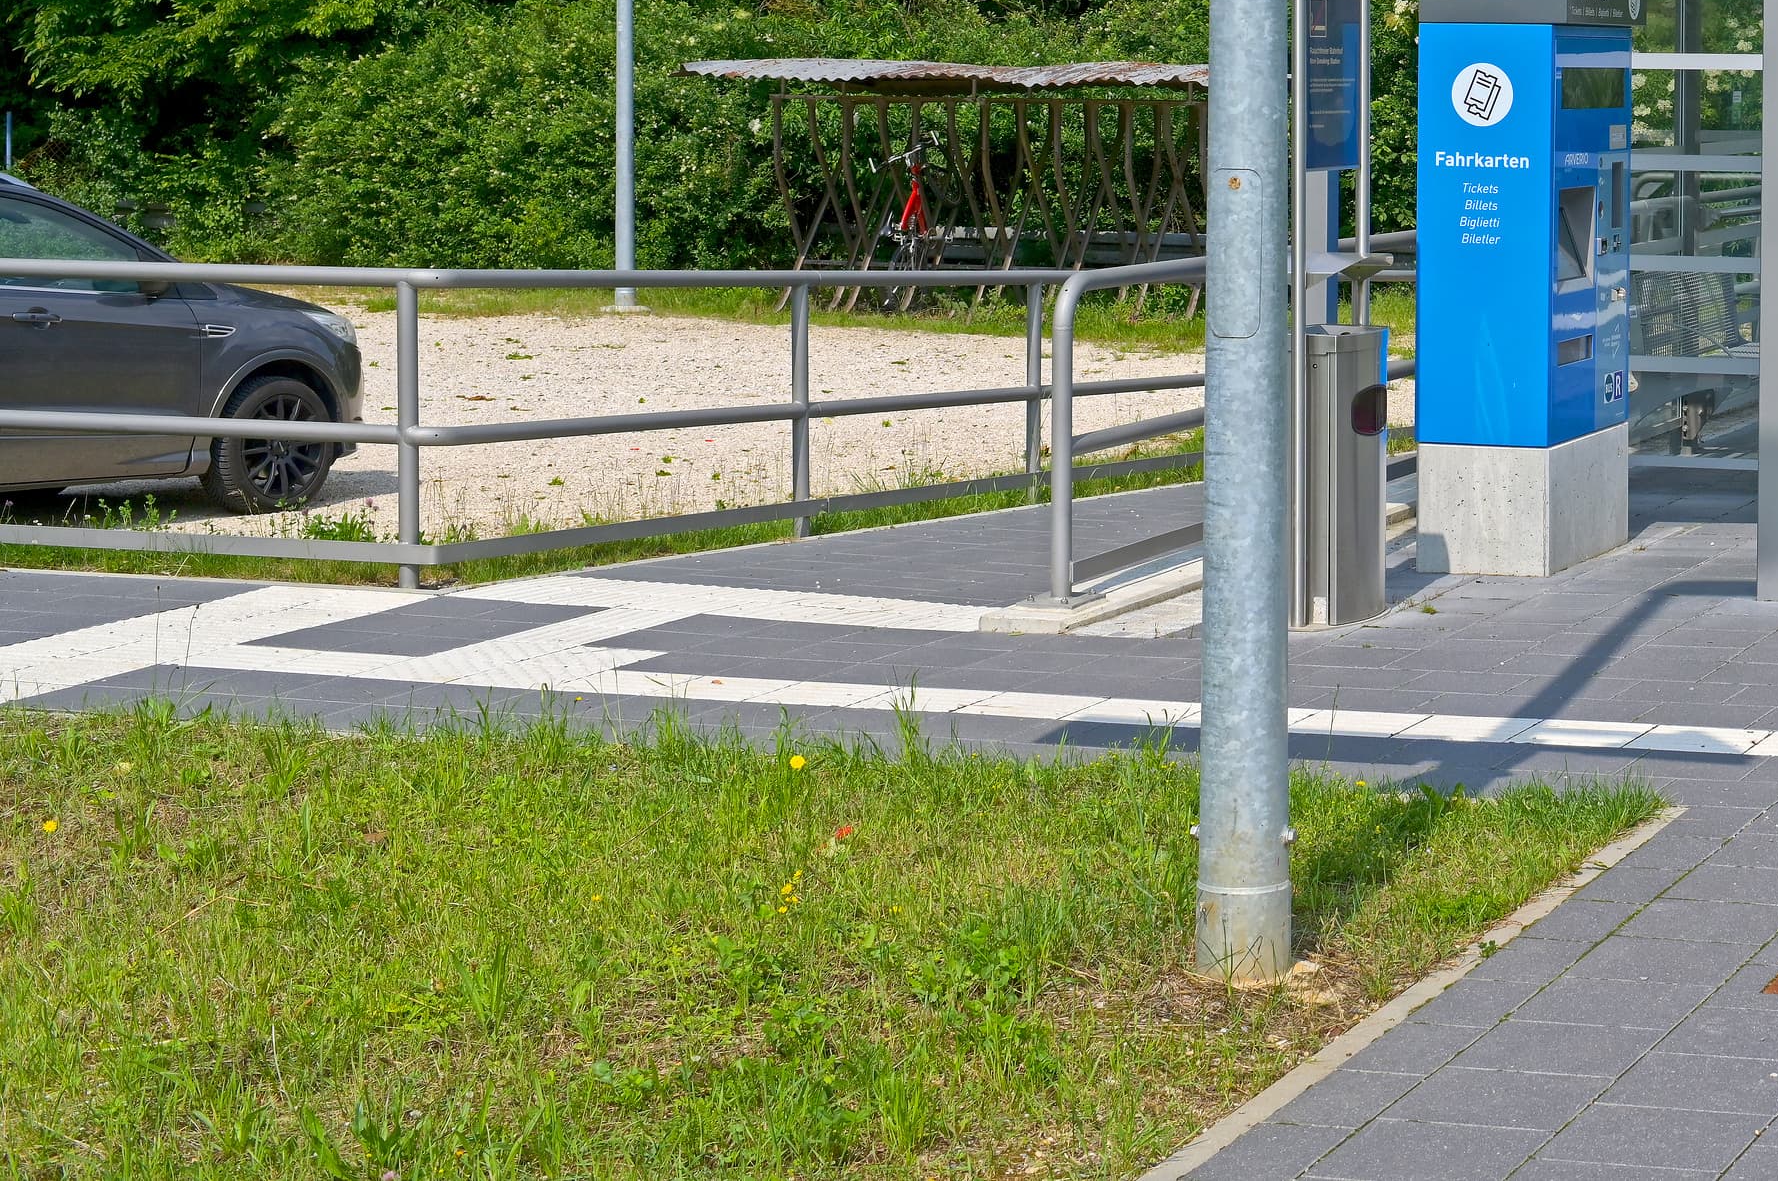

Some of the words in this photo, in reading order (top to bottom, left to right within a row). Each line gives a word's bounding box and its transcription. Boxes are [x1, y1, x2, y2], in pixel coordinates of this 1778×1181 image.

[1435, 151, 1530, 169] Fahrkarten
[1463, 182, 1499, 194] Tickets
[1464, 199, 1498, 211] Billets
[1459, 216, 1501, 230] Biglietti
[1461, 233, 1501, 245] Biletler
[1615, 374, 1621, 398] R
